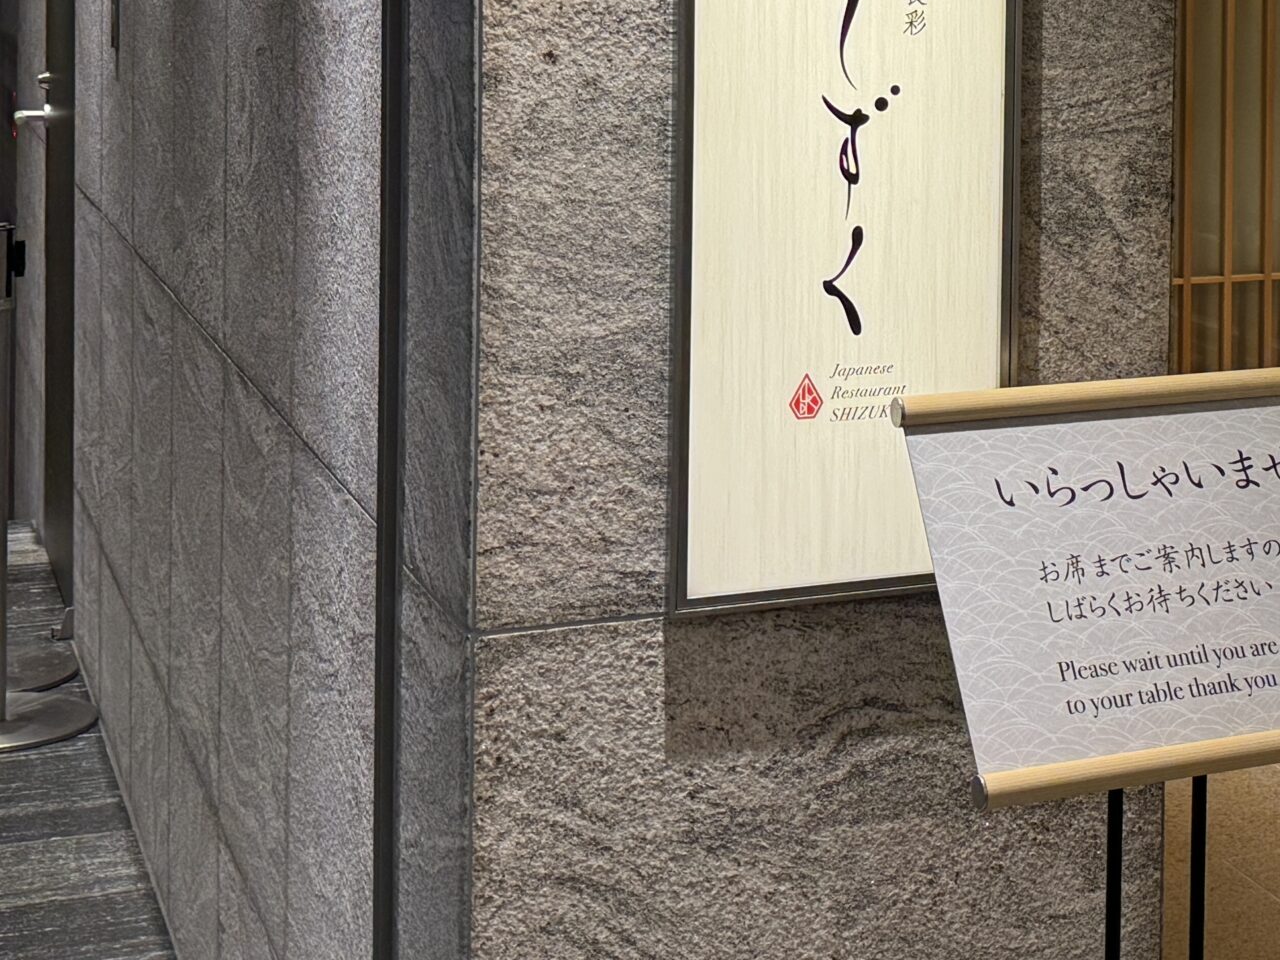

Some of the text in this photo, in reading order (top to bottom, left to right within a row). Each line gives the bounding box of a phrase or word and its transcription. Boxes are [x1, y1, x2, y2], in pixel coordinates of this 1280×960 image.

[829, 363, 894, 381] Japanese
[830, 384, 907, 400] Restaurant
[829, 404, 891, 422] SHIZUK
[1047, 578, 1274, 623] しばらくお待ちください
[1057, 659, 1120, 682] Please
[1122, 650, 1162, 673] wait
[1167, 643, 1210, 668] until
[1212, 644, 1247, 668] you
[1249, 638, 1279, 658] are
[1065, 672, 1278, 718] to your table thank you
